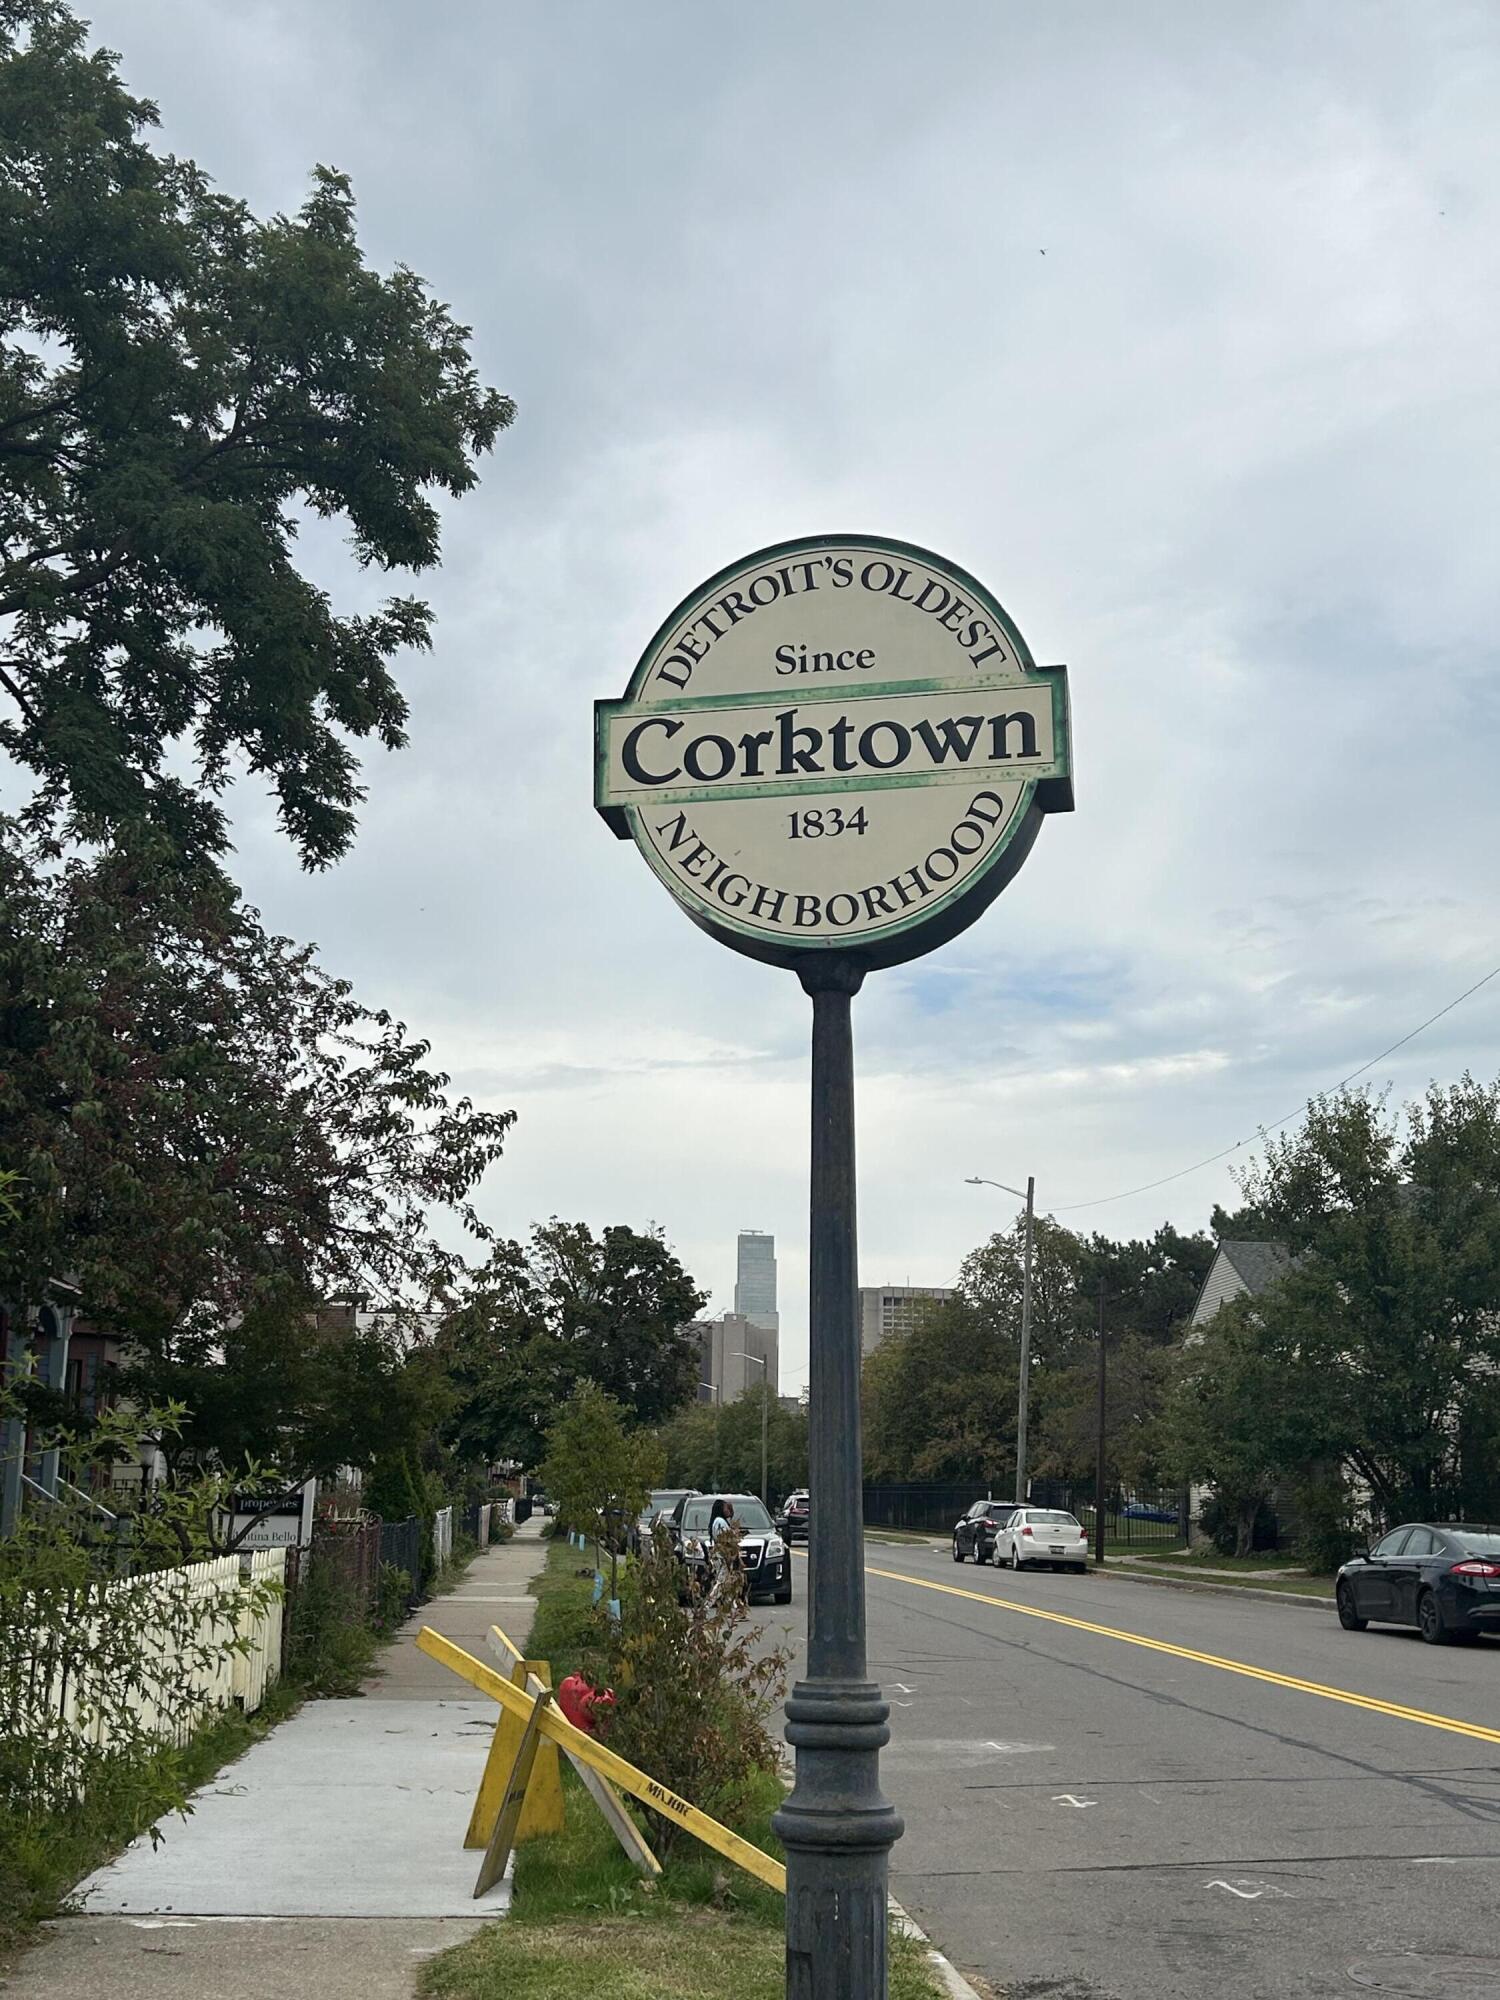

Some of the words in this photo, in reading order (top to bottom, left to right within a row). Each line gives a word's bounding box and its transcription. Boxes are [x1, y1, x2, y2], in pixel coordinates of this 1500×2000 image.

[656, 556, 854, 690] DETROIT'S
[861, 561, 1007, 669] OLDEST
[775, 643, 876, 675] Since
[622, 708, 1042, 785] Corktown
[788, 805, 869, 840] 1834
[655, 790, 1004, 928] NEIGHBORHOOD
[240, 1498, 298, 1511] propeies
[272, 1531, 297, 1541] Bello
